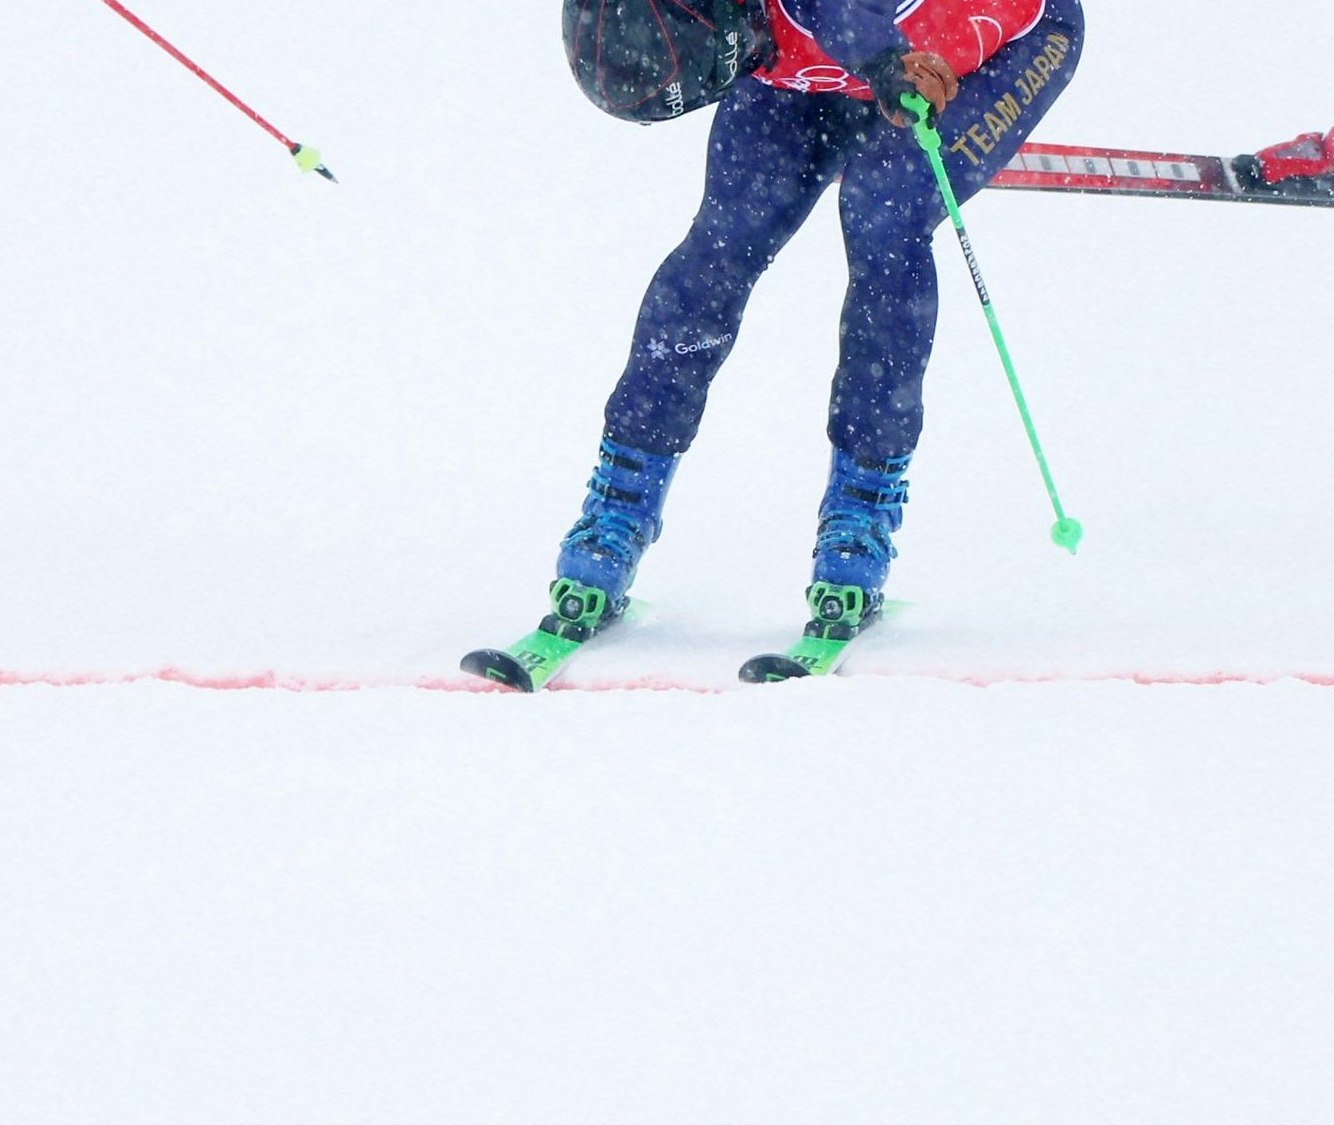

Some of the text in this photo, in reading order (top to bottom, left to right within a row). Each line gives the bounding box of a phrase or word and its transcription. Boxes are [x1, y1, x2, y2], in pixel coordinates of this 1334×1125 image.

[949, 92, 1022, 166] TEAM
[1014, 31, 1070, 106] JAPAN
[674, 332, 733, 354] Goldwin
